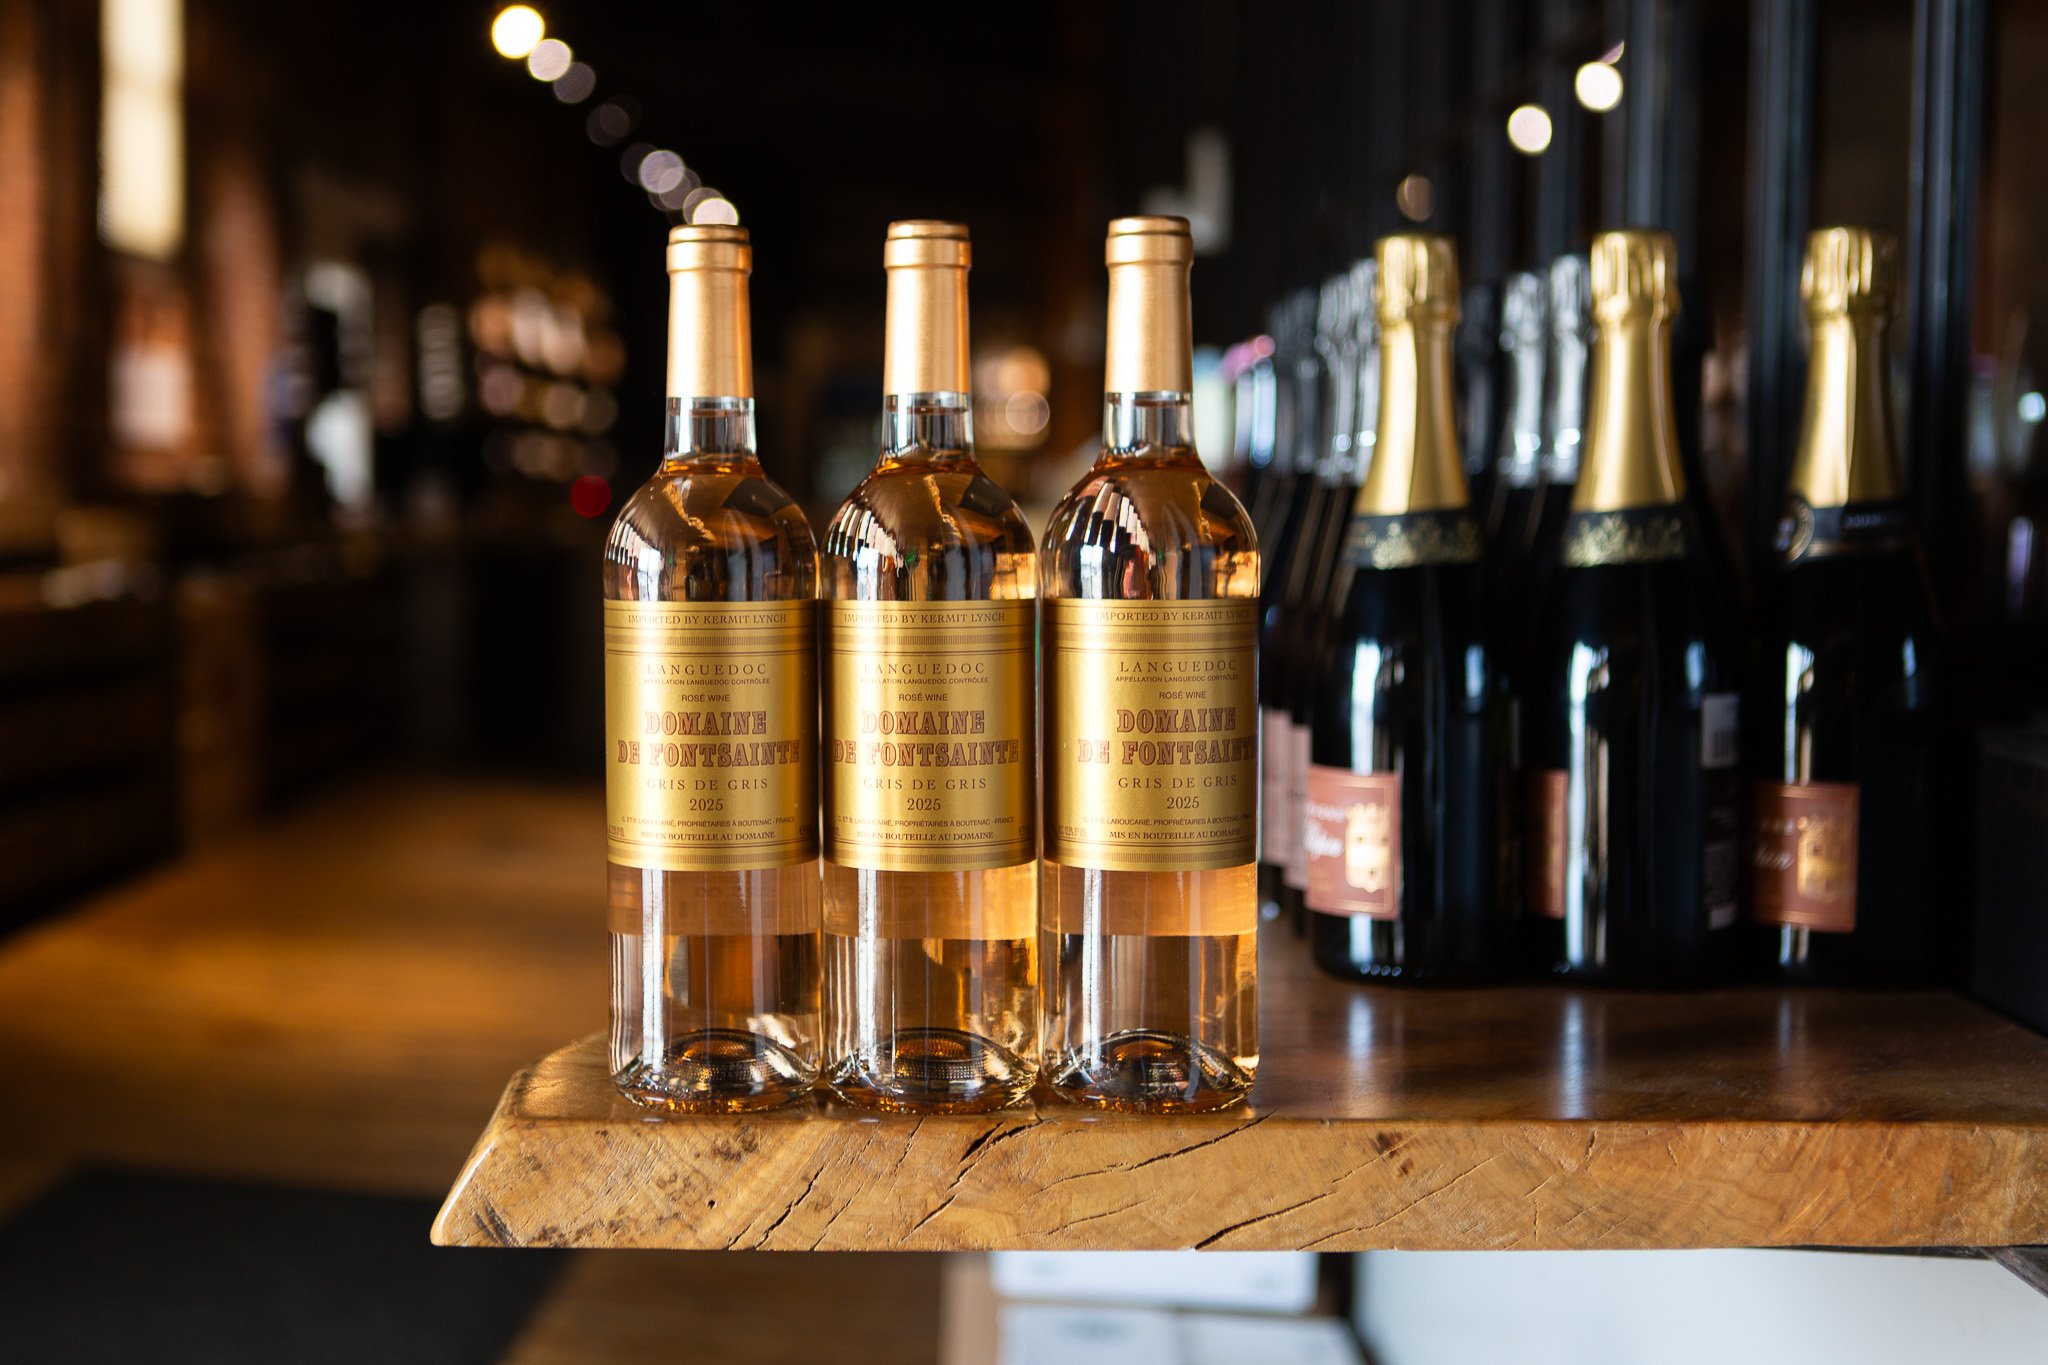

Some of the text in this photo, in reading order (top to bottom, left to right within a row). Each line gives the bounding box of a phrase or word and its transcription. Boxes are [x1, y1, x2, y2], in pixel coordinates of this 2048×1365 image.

[628, 614, 787, 624] IMPORTED BY KERMIT LYNCH
[844, 613, 1006, 623] IMPORTED BY KERMIT LYNCH
[1096, 612, 1159, 621] IMPORTED
[1163, 612, 1178, 621] BY
[1182, 611, 1223, 620] KERMIT
[647, 664, 767, 676] LANGUEDOC
[864, 663, 985, 675] LANGUEDOC
[1120, 659, 1237, 672] LANGUEDOC
[731, 677, 771, 685] CONTRÔLÉE
[948, 676, 989, 684] CONTRÔLÉE
[681, 692, 730, 702] ROSÉ WINE
[898, 692, 948, 701] ROSÉ WINE
[1159, 690, 1207, 699] ROSÉ WINE
[645, 711, 767, 735] DOMAINE
[862, 710, 985, 735] DOMAINE
[1117, 707, 1236, 733] DOMAINE
[617, 740, 800, 767] DE FONTSAINTE
[834, 739, 1019, 767] DE FONTSAINTE
[1078, 739, 1110, 764] DE
[647, 778, 769, 791] GRIS DE GRIS
[863, 778, 987, 790] GRIS DE GRIS
[1118, 775, 1237, 789] GRIS DE GRIS
[689, 798, 724, 811] 2025
[907, 798, 941, 811] 2025
[1166, 797, 1200, 810] 2025
[678, 819, 731, 828] PROPRIÉTAIRES
[738, 818, 771, 827] BOUTENAC
[895, 819, 949, 828] PROPRIÉTAIRES
[956, 818, 990, 827] BOUTENAC
[994, 816, 1015, 824] FRANCE
[1107, 817, 1152, 826] LABOUCARIÉ,
[1153, 818, 1206, 826] PROPRIÉTAIRES
[668, 833, 719, 841] BOUTEILLE
[720, 832, 733, 841] AU
[735, 831, 776, 841] DOMAINE
[885, 833, 937, 841] BOUTEILLE
[938, 832, 951, 840] AU
[953, 831, 994, 840] DOMAINE
[1109, 831, 1126, 839] MIS
[1143, 832, 1195, 840] BOUTEILLE
[1197, 830, 1209, 839] AU
